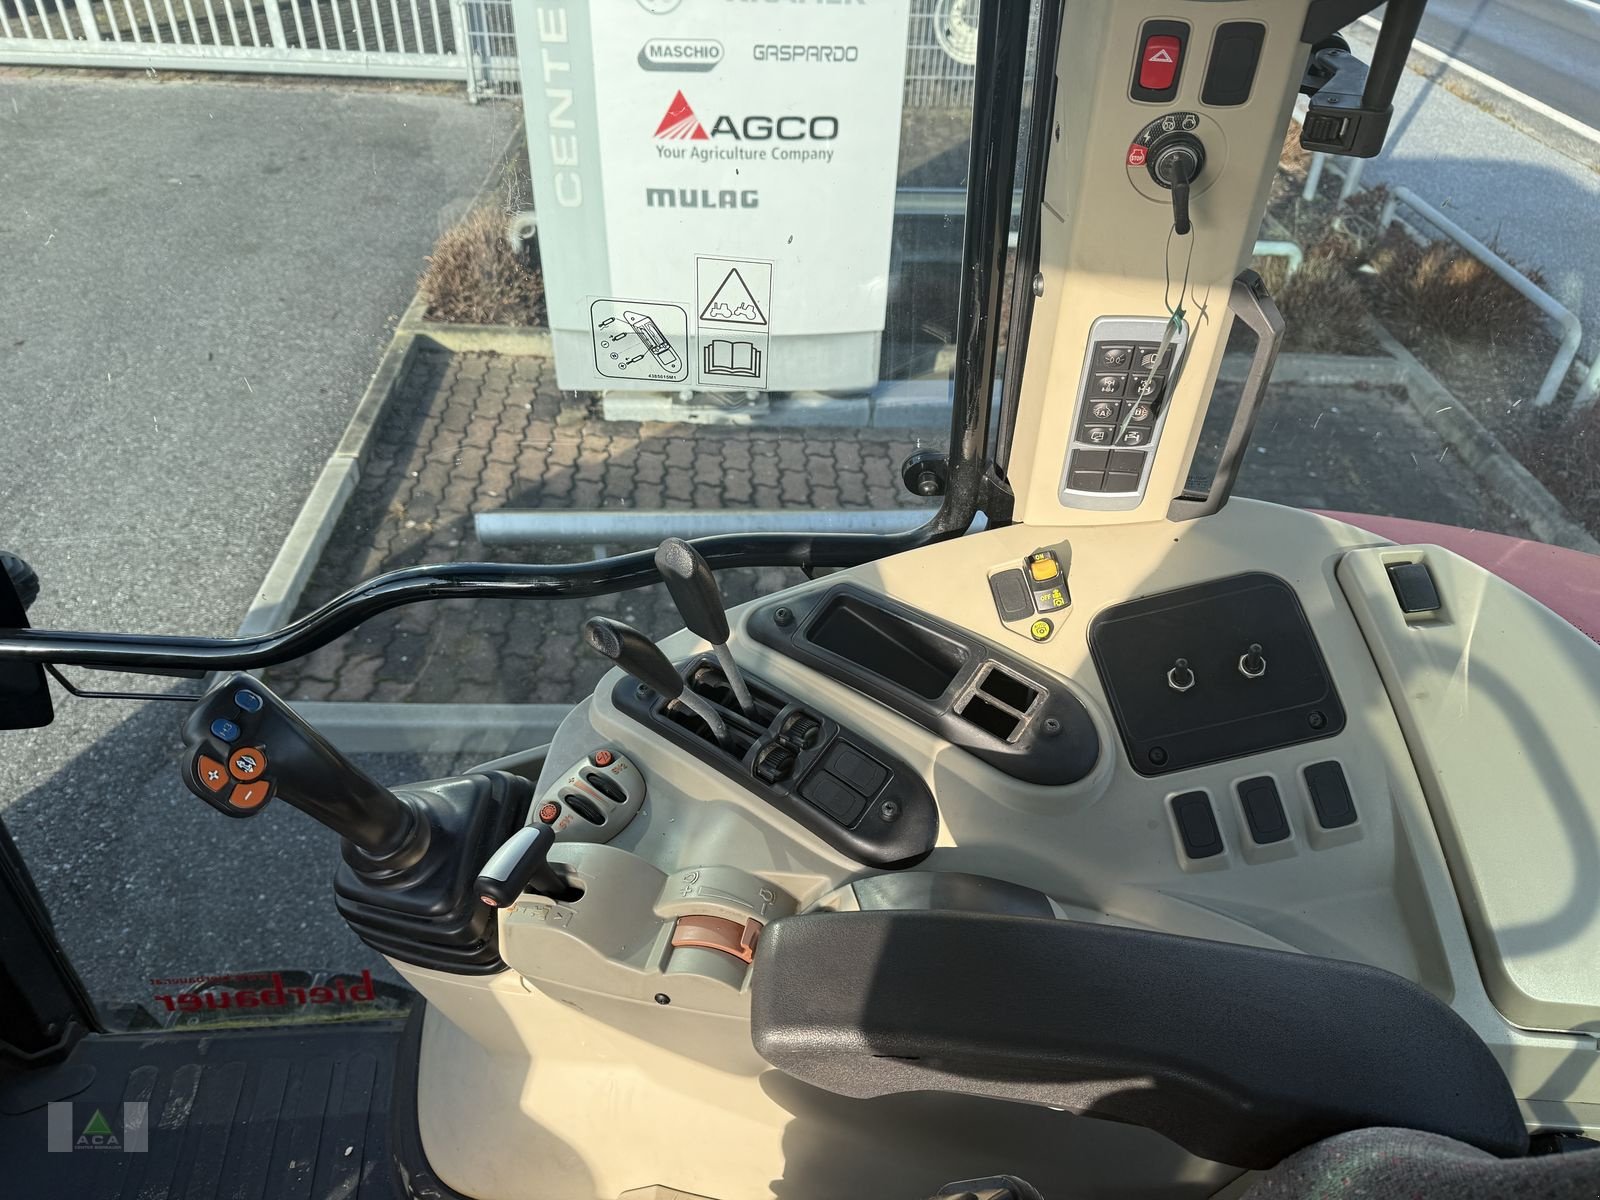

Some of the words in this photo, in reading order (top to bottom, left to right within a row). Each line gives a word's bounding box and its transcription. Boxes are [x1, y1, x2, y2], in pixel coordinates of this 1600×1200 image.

[650, 45, 720, 59] MASCHIO
[753, 45, 858, 62] GASPARDO
[710, 115, 839, 141] AGCO
[656, 145, 686, 159] Your
[690, 146, 767, 163] Agriculture
[771, 147, 835, 163] Company
[646, 188, 760, 209] MULAG
[1040, 593, 1051, 602] OFF
